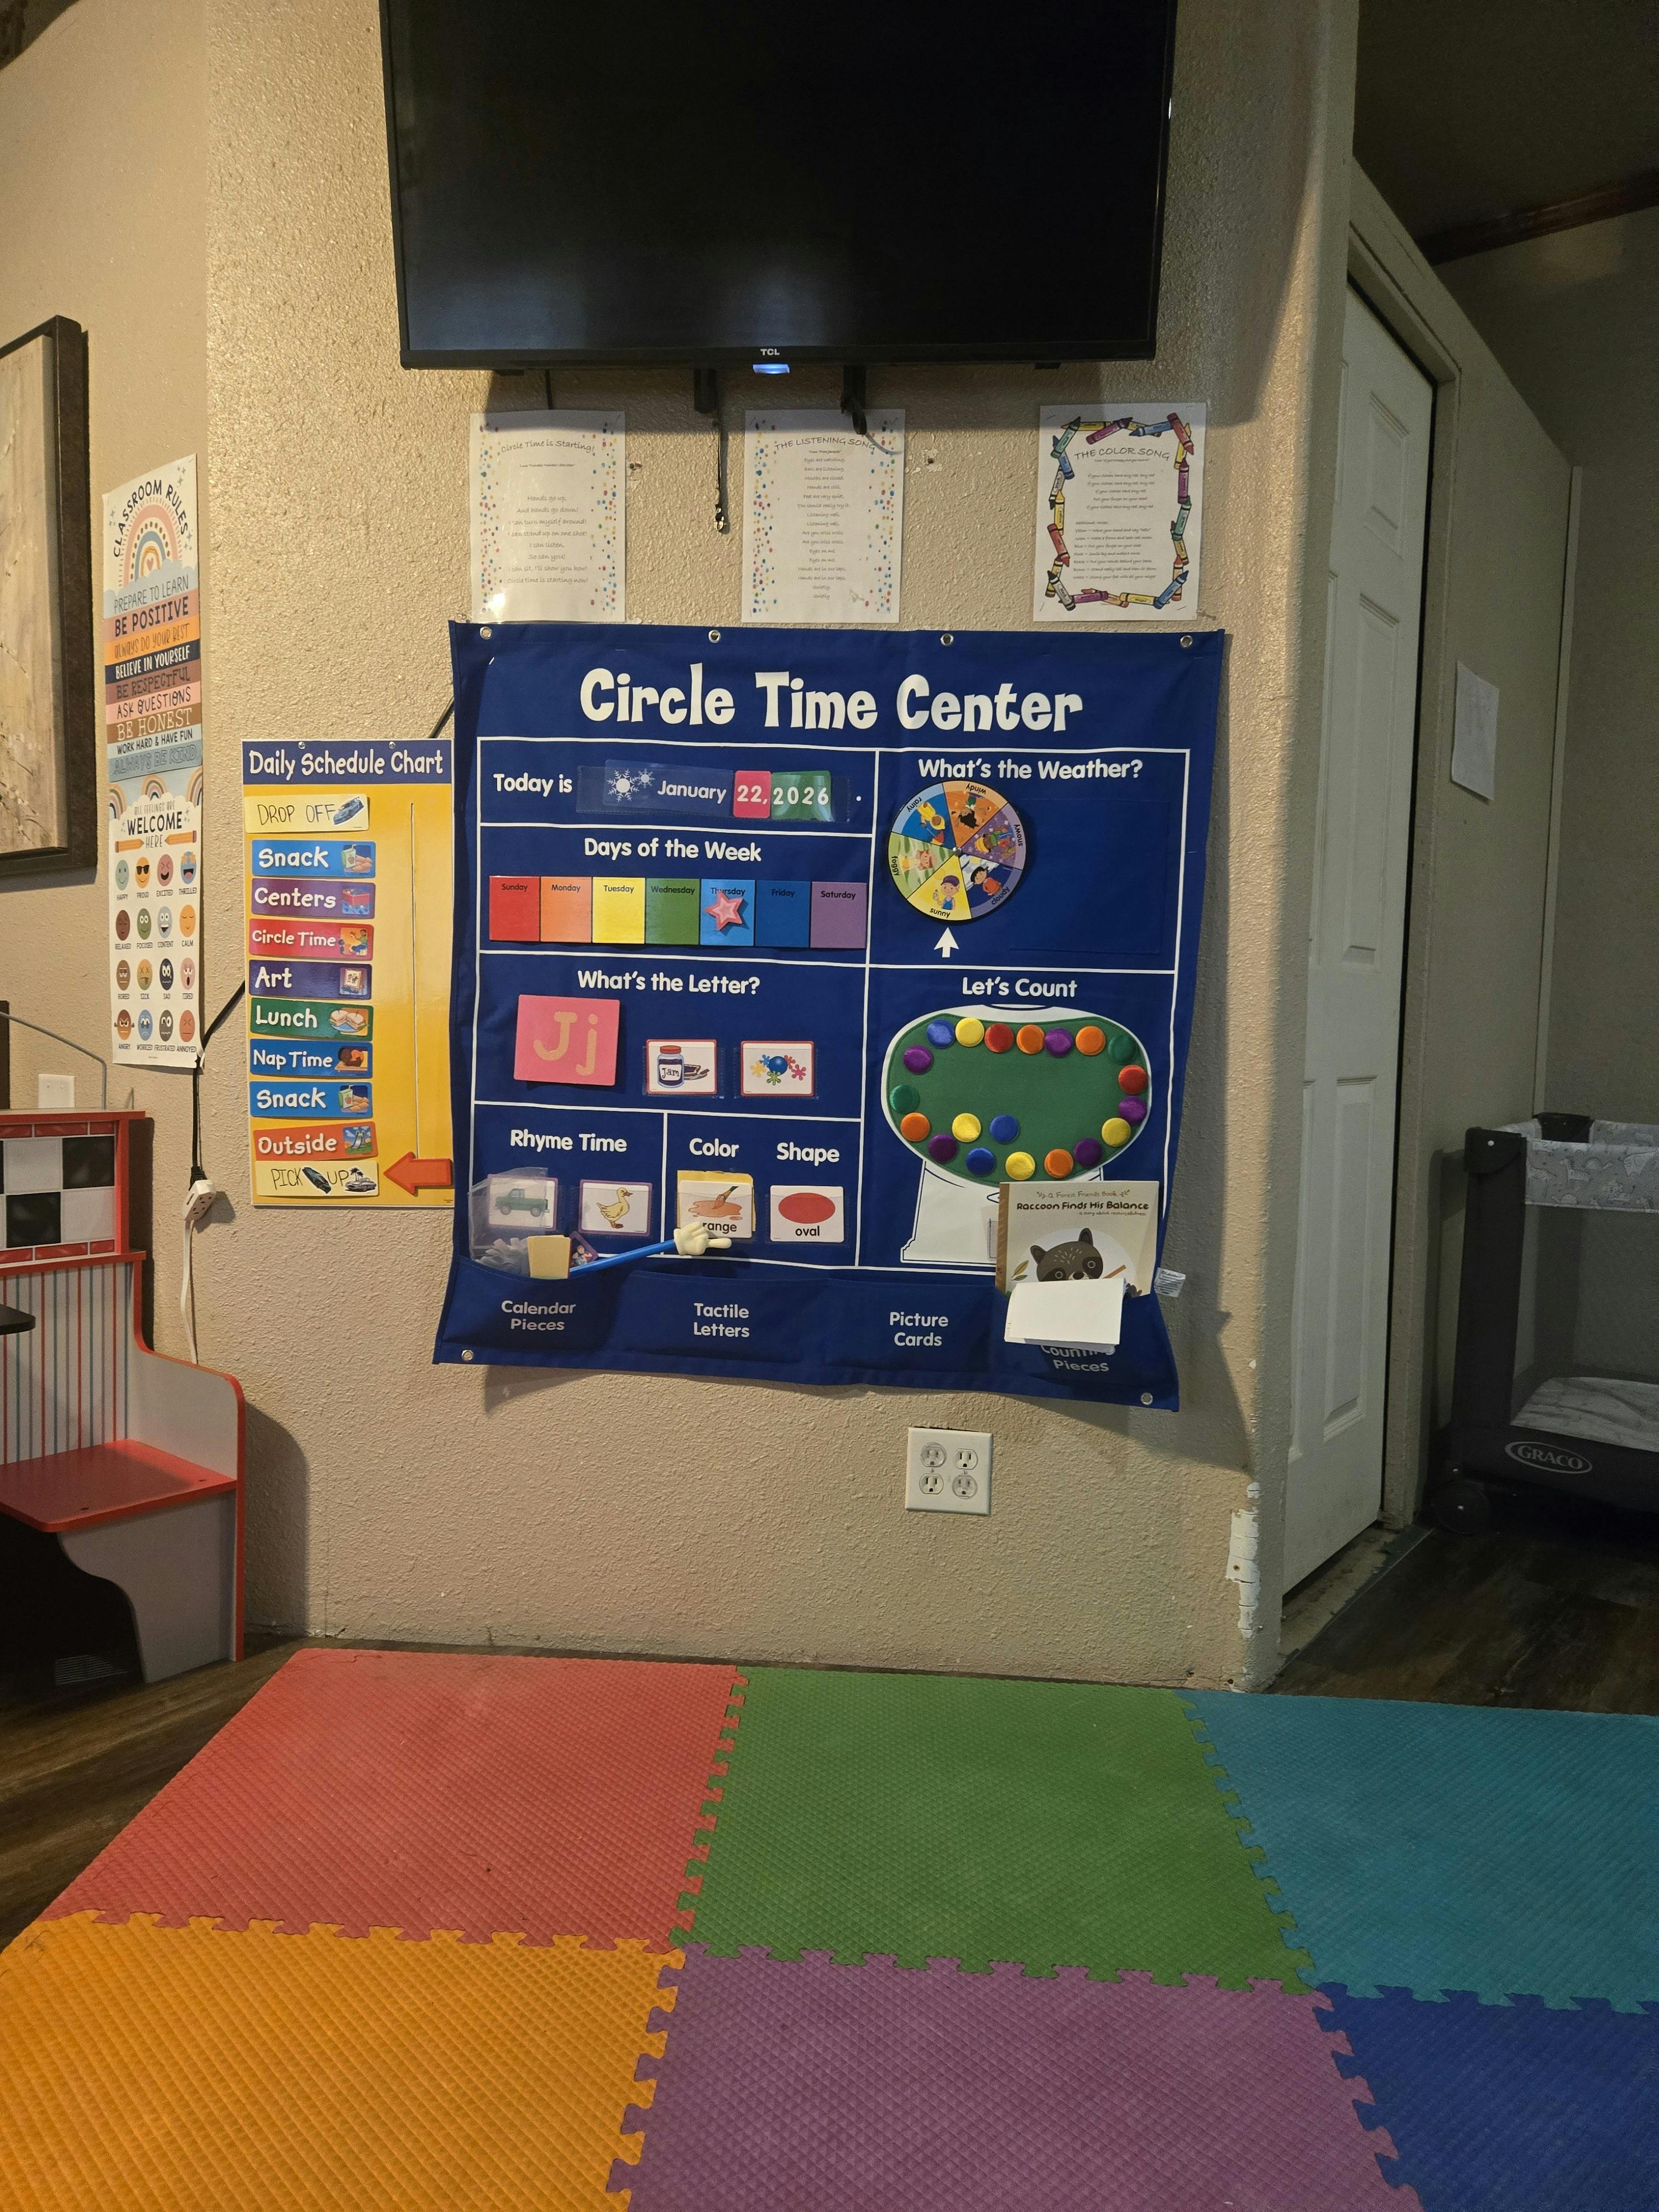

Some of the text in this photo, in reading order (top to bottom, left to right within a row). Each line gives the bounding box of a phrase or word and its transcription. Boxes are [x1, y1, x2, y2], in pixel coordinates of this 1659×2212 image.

[501, 442, 523, 452] Circle
[525, 440, 545, 448] Time
[555, 440, 594, 453] Starting!
[774, 437, 877, 451] THE LISTENING SONG
[1074, 449, 1097, 460] THE
[1138, 448, 1170, 461] SONG
[114, 480, 187, 557] CLASSROOM RULES
[114, 575, 189, 614] PREPARE TO LEARN
[115, 596, 189, 637] BE POSITIVE
[173, 623, 190, 641] BEST
[115, 645, 190, 679] BELIEVE IN YOURSELF
[116, 666, 190, 700] BE RESPECTFUL
[117, 686, 191, 719] ASK QUESTIONS
[580, 662, 1083, 732] Circle Time Center
[117, 707, 192, 741] BE HONEST
[117, 728, 193, 755] WORK HARD & HAVE FUN
[113, 744, 197, 774] ALWAYS BE KIND
[249, 749, 443, 781] Daily Schedule Chart
[919, 759, 1143, 780] What's the Weather?
[493, 773, 554, 796] Today
[559, 774, 573, 793] is
[658, 780, 727, 804] January
[773, 787, 830, 805] 2026
[966, 783, 987, 794] windy
[257, 804, 336, 825] DROP OFF
[907, 797, 922, 812] rainy
[127, 811, 182, 836] WELCOME
[145, 834, 163, 848] HERE
[1014, 824, 1024, 847] snowy
[258, 846, 328, 869] Snack
[584, 838, 762, 862] Days of the Week
[891, 856, 900, 877] foggy
[254, 887, 336, 908] Centers
[551, 884, 581, 892] Monday
[603, 885, 634, 893] Tuesday
[651, 886, 695, 895] Wednesday
[771, 889, 795, 898] Friday
[821, 890, 856, 900] Saturday
[991, 886, 1011, 905] cloudy
[930, 907, 951, 919] sunny
[252, 930, 336, 947] Circle Time
[254, 966, 292, 989] Art
[578, 970, 760, 995] What's the Letter?
[962, 977, 1077, 998] Let's Count
[255, 1005, 317, 1029] Lunch
[253, 1049, 333, 1070] Nap Time
[662, 1067, 680, 1078] Jam
[257, 1088, 327, 1109] Snack
[258, 1133, 337, 1155] Outside
[510, 1129, 627, 1152] Rhyme Time
[689, 1138, 739, 1158] Color
[776, 1142, 840, 1167] Shape
[270, 1168, 349, 1190] PICK UP
[1090, 1201, 1104, 1209] His
[1107, 1201, 1149, 1209] Balance
[703, 1222, 737, 1234] range
[795, 1225, 820, 1237] oval
[501, 1300, 577, 1316] Calendar
[693, 1302, 749, 1319] Tactile
[510, 1318, 565, 1332] Pieces
[889, 1311, 949, 1327] Picture
[693, 1322, 750, 1338] Letters
[894, 1332, 942, 1347] Cards
[1052, 1359, 1109, 1371] Pieces
[1517, 1445, 1583, 1469] GRACO
